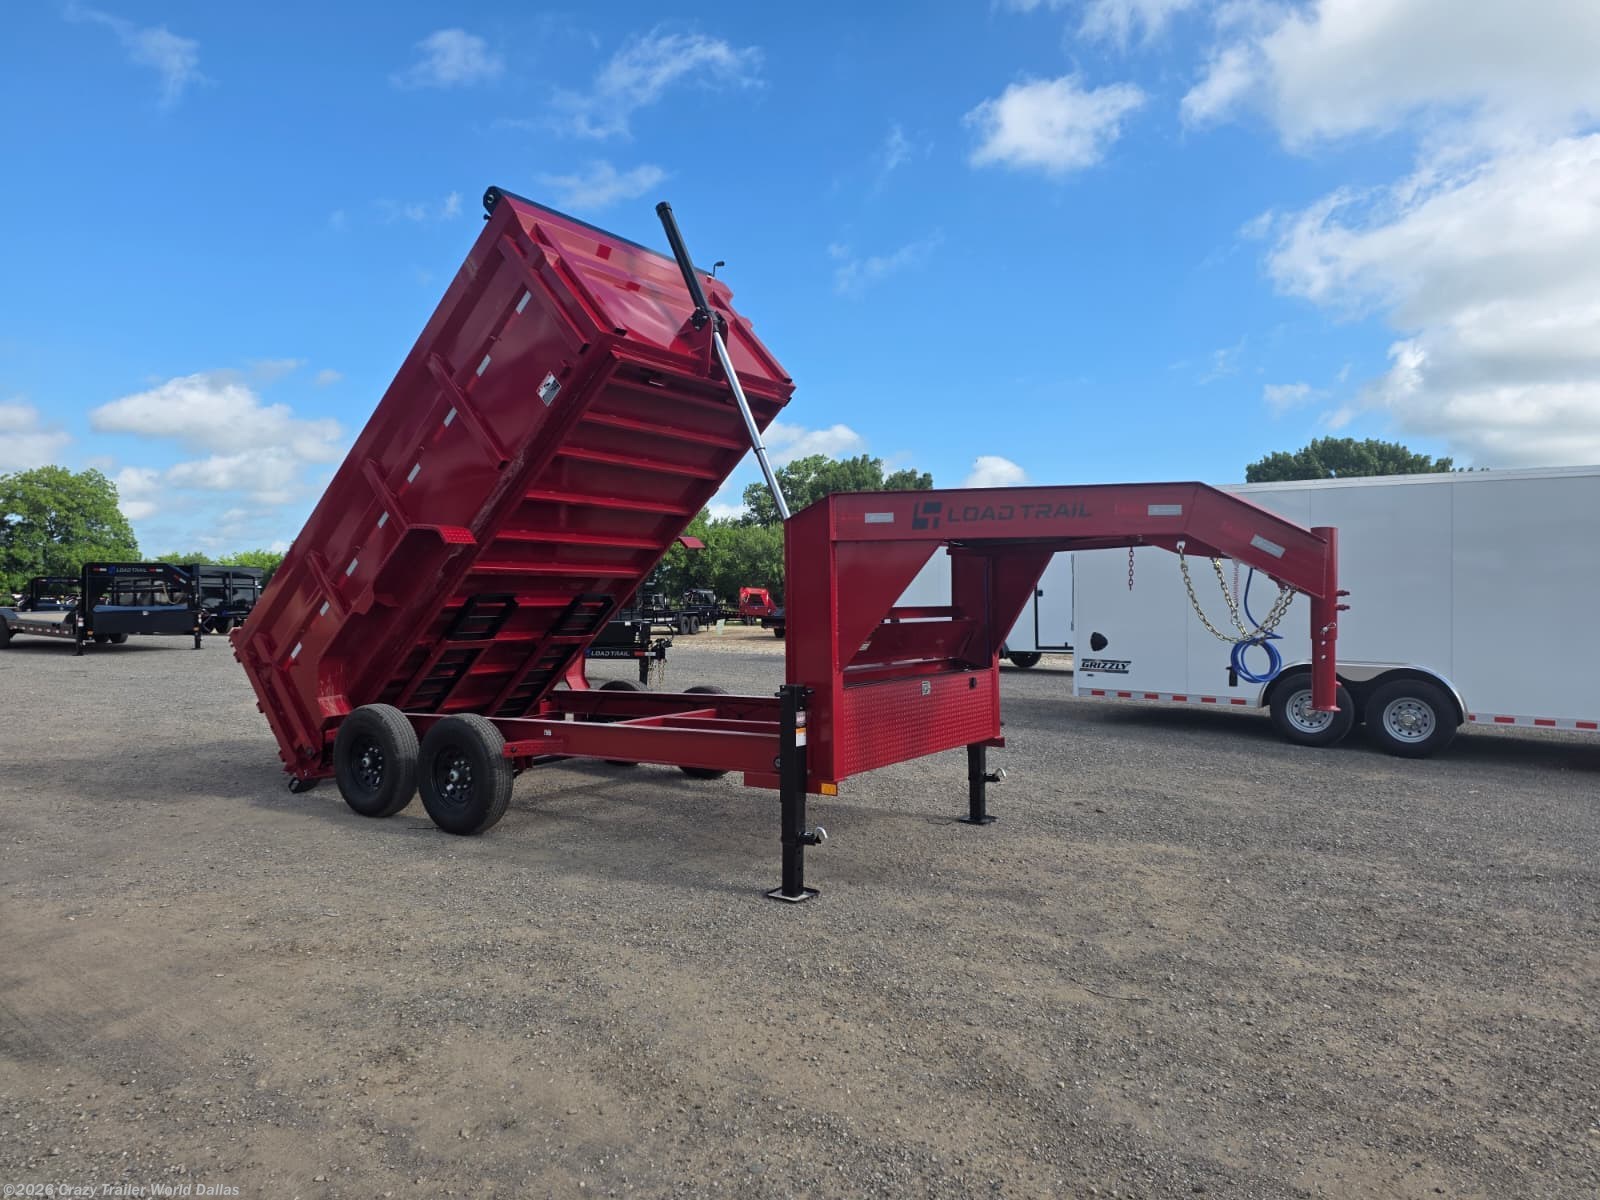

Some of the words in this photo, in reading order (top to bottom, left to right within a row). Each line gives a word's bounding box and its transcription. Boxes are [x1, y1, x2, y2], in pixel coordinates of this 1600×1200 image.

[947, 505, 1014, 523] LOAD
[1020, 501, 1092, 520] TRAIL
[1081, 661, 1128, 670] GRIZZLY
